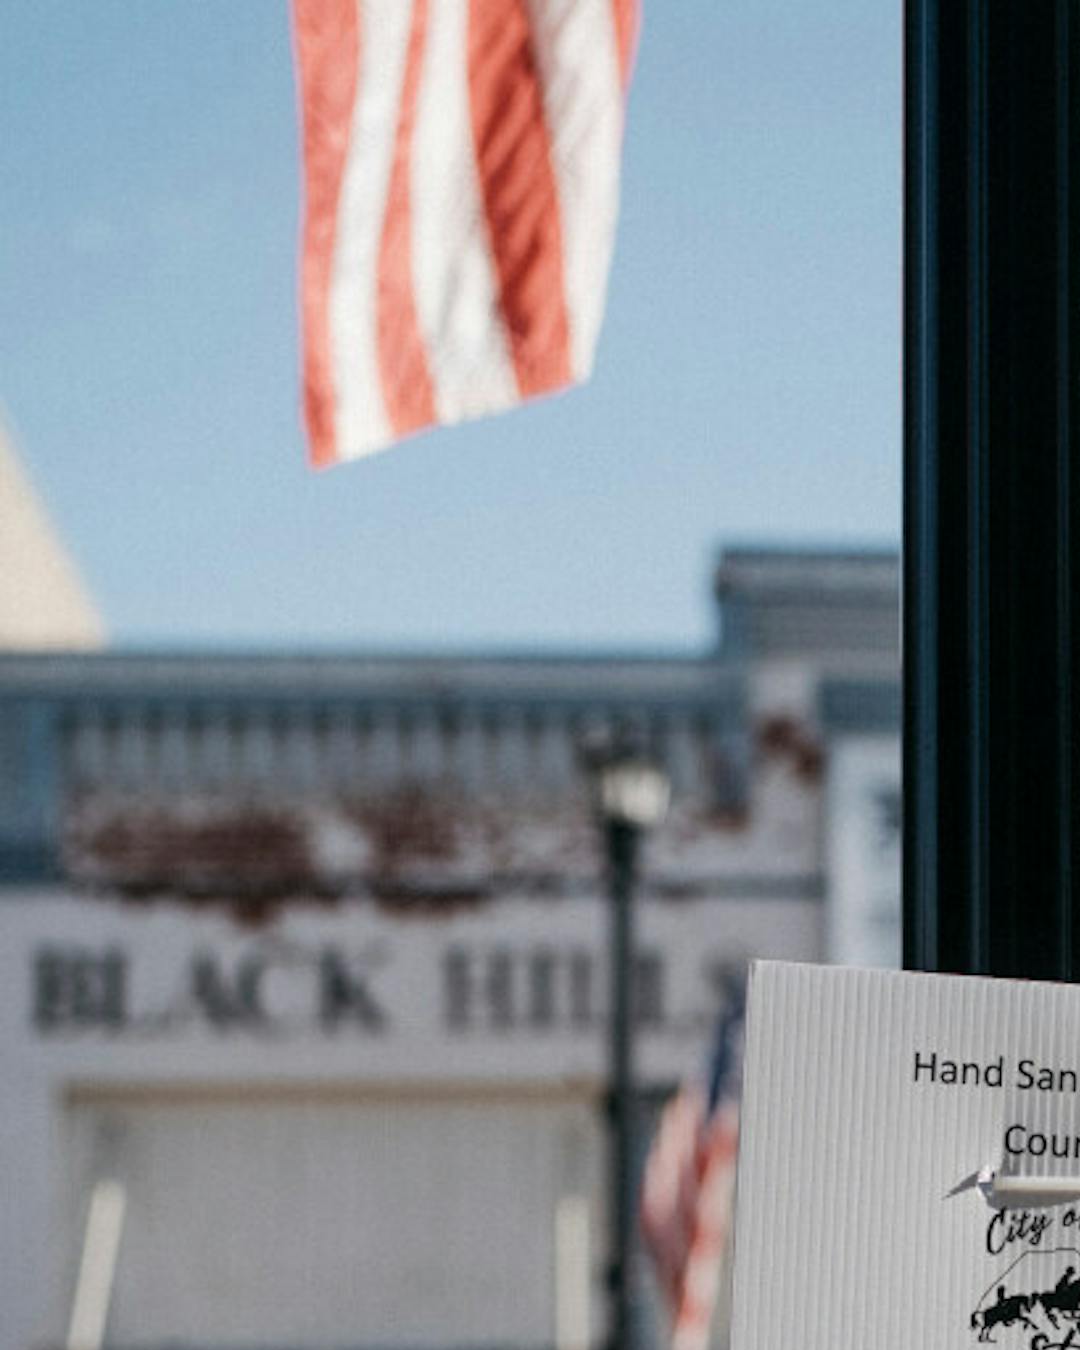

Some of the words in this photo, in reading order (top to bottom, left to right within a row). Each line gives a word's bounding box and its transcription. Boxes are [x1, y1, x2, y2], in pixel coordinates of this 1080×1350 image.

[30, 944, 390, 1042] BLACK
[912, 1052, 1005, 1089] Hand
[985, 1206, 1052, 1256] City
